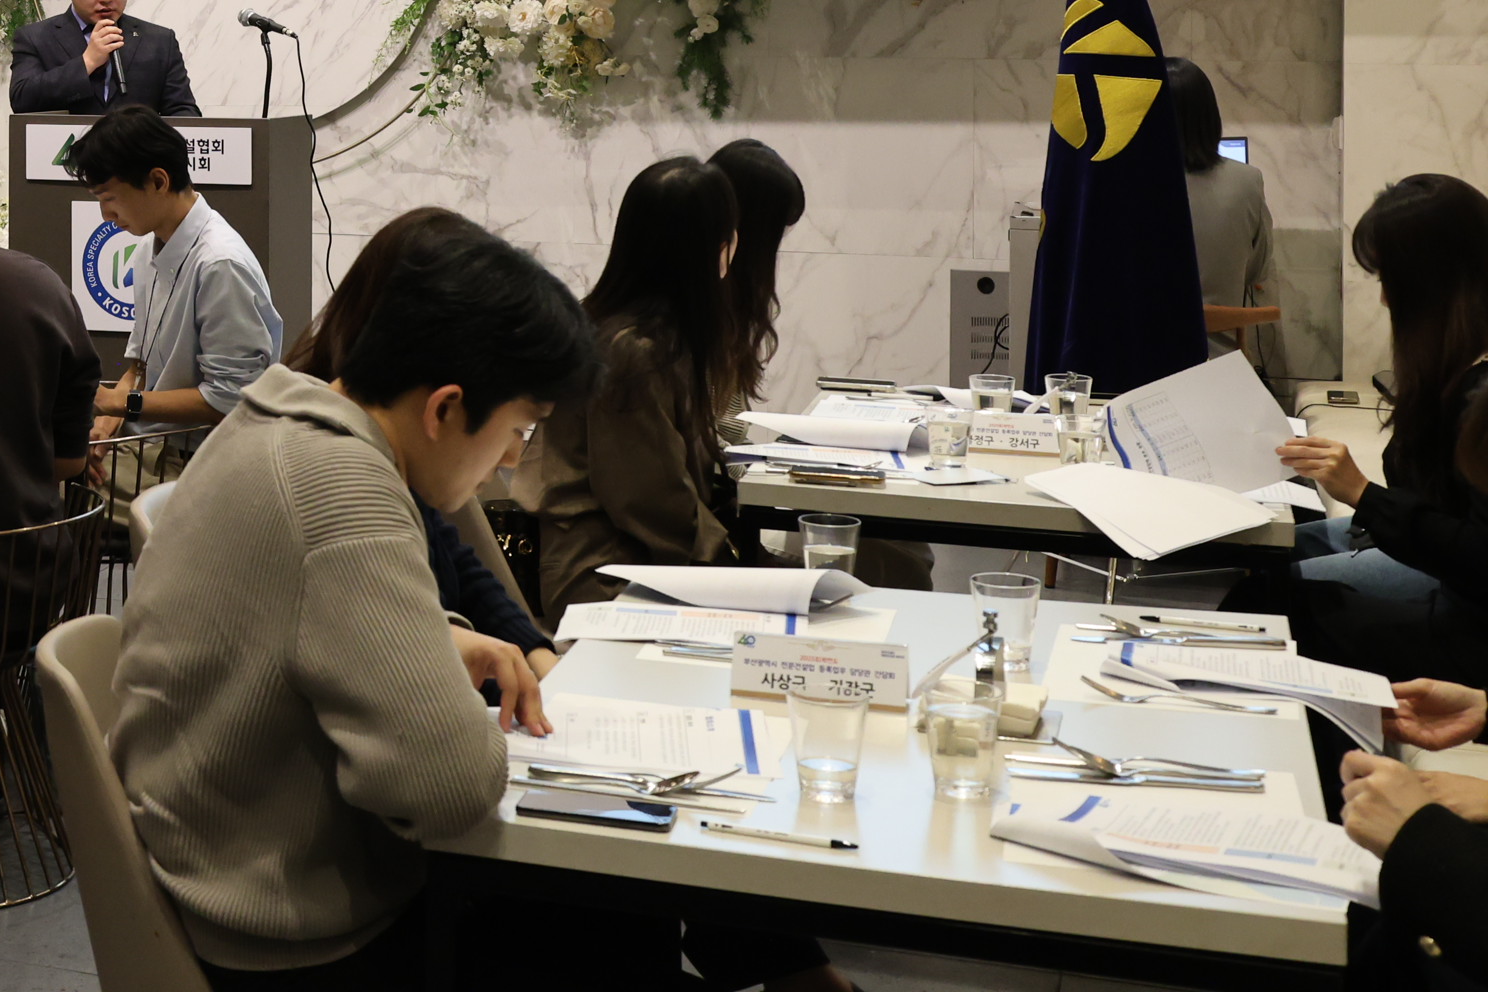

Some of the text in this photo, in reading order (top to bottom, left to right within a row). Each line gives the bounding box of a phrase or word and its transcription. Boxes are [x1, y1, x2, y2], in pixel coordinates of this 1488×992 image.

[86, 224, 112, 288] KOREA SPECIALTY
[102, 296, 136, 319] KOS
[1008, 437, 1041, 449] 강서구
[761, 671, 807, 692] 사상구
